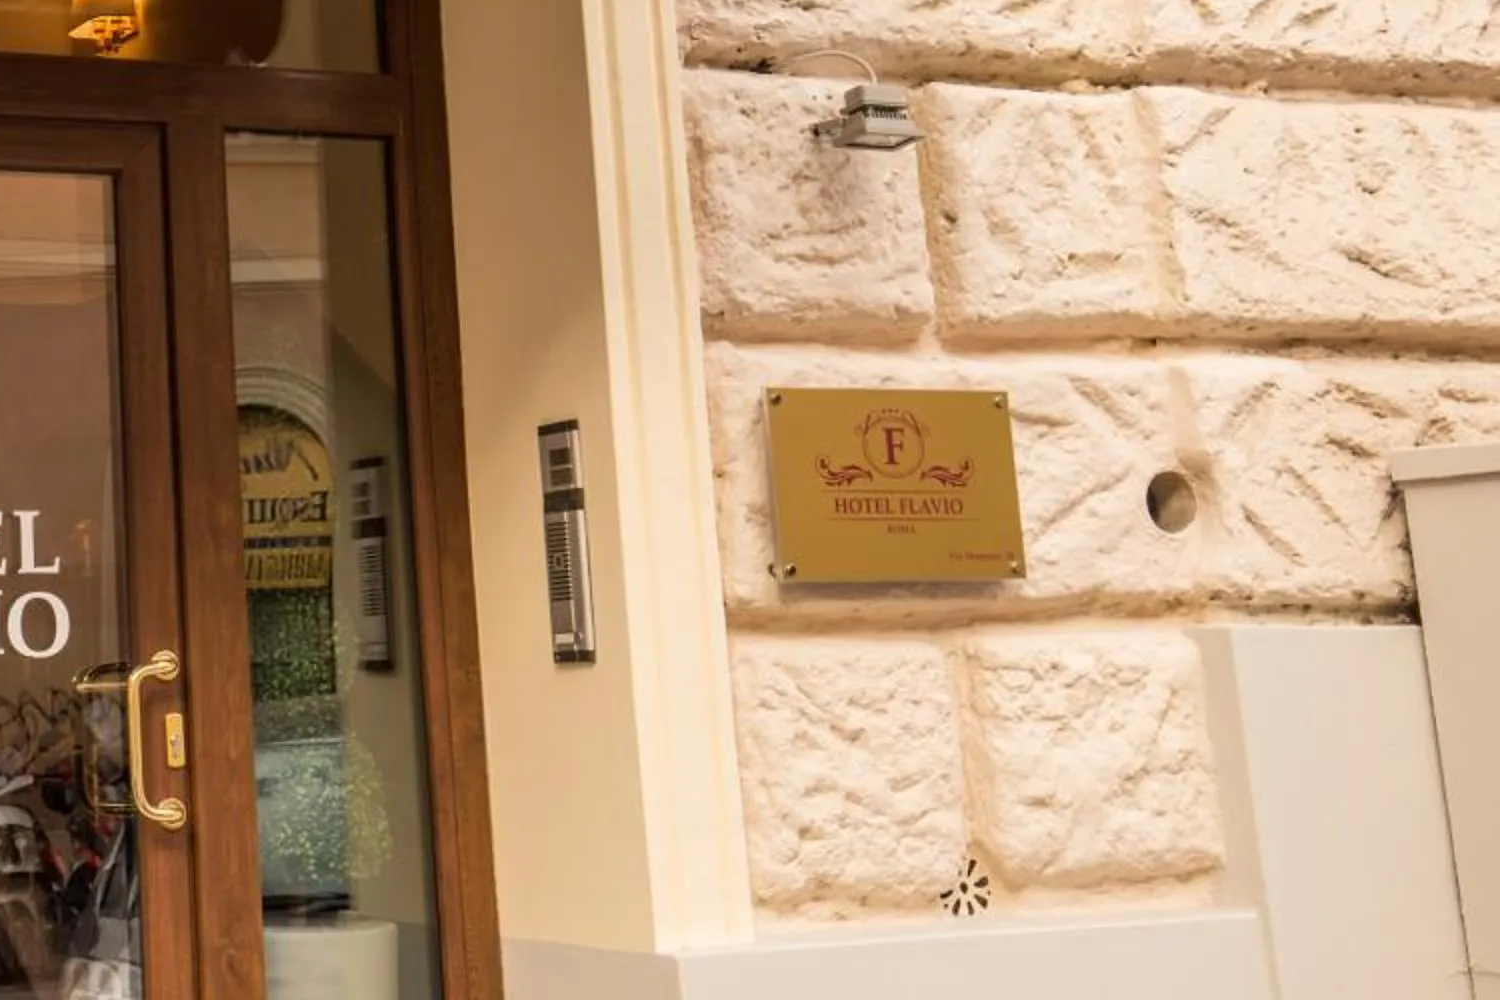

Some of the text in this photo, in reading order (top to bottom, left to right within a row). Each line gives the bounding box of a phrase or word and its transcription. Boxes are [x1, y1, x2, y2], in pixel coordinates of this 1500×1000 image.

[881, 427, 905, 465] F
[834, 496, 964, 516] HOTEL FLAVIO
